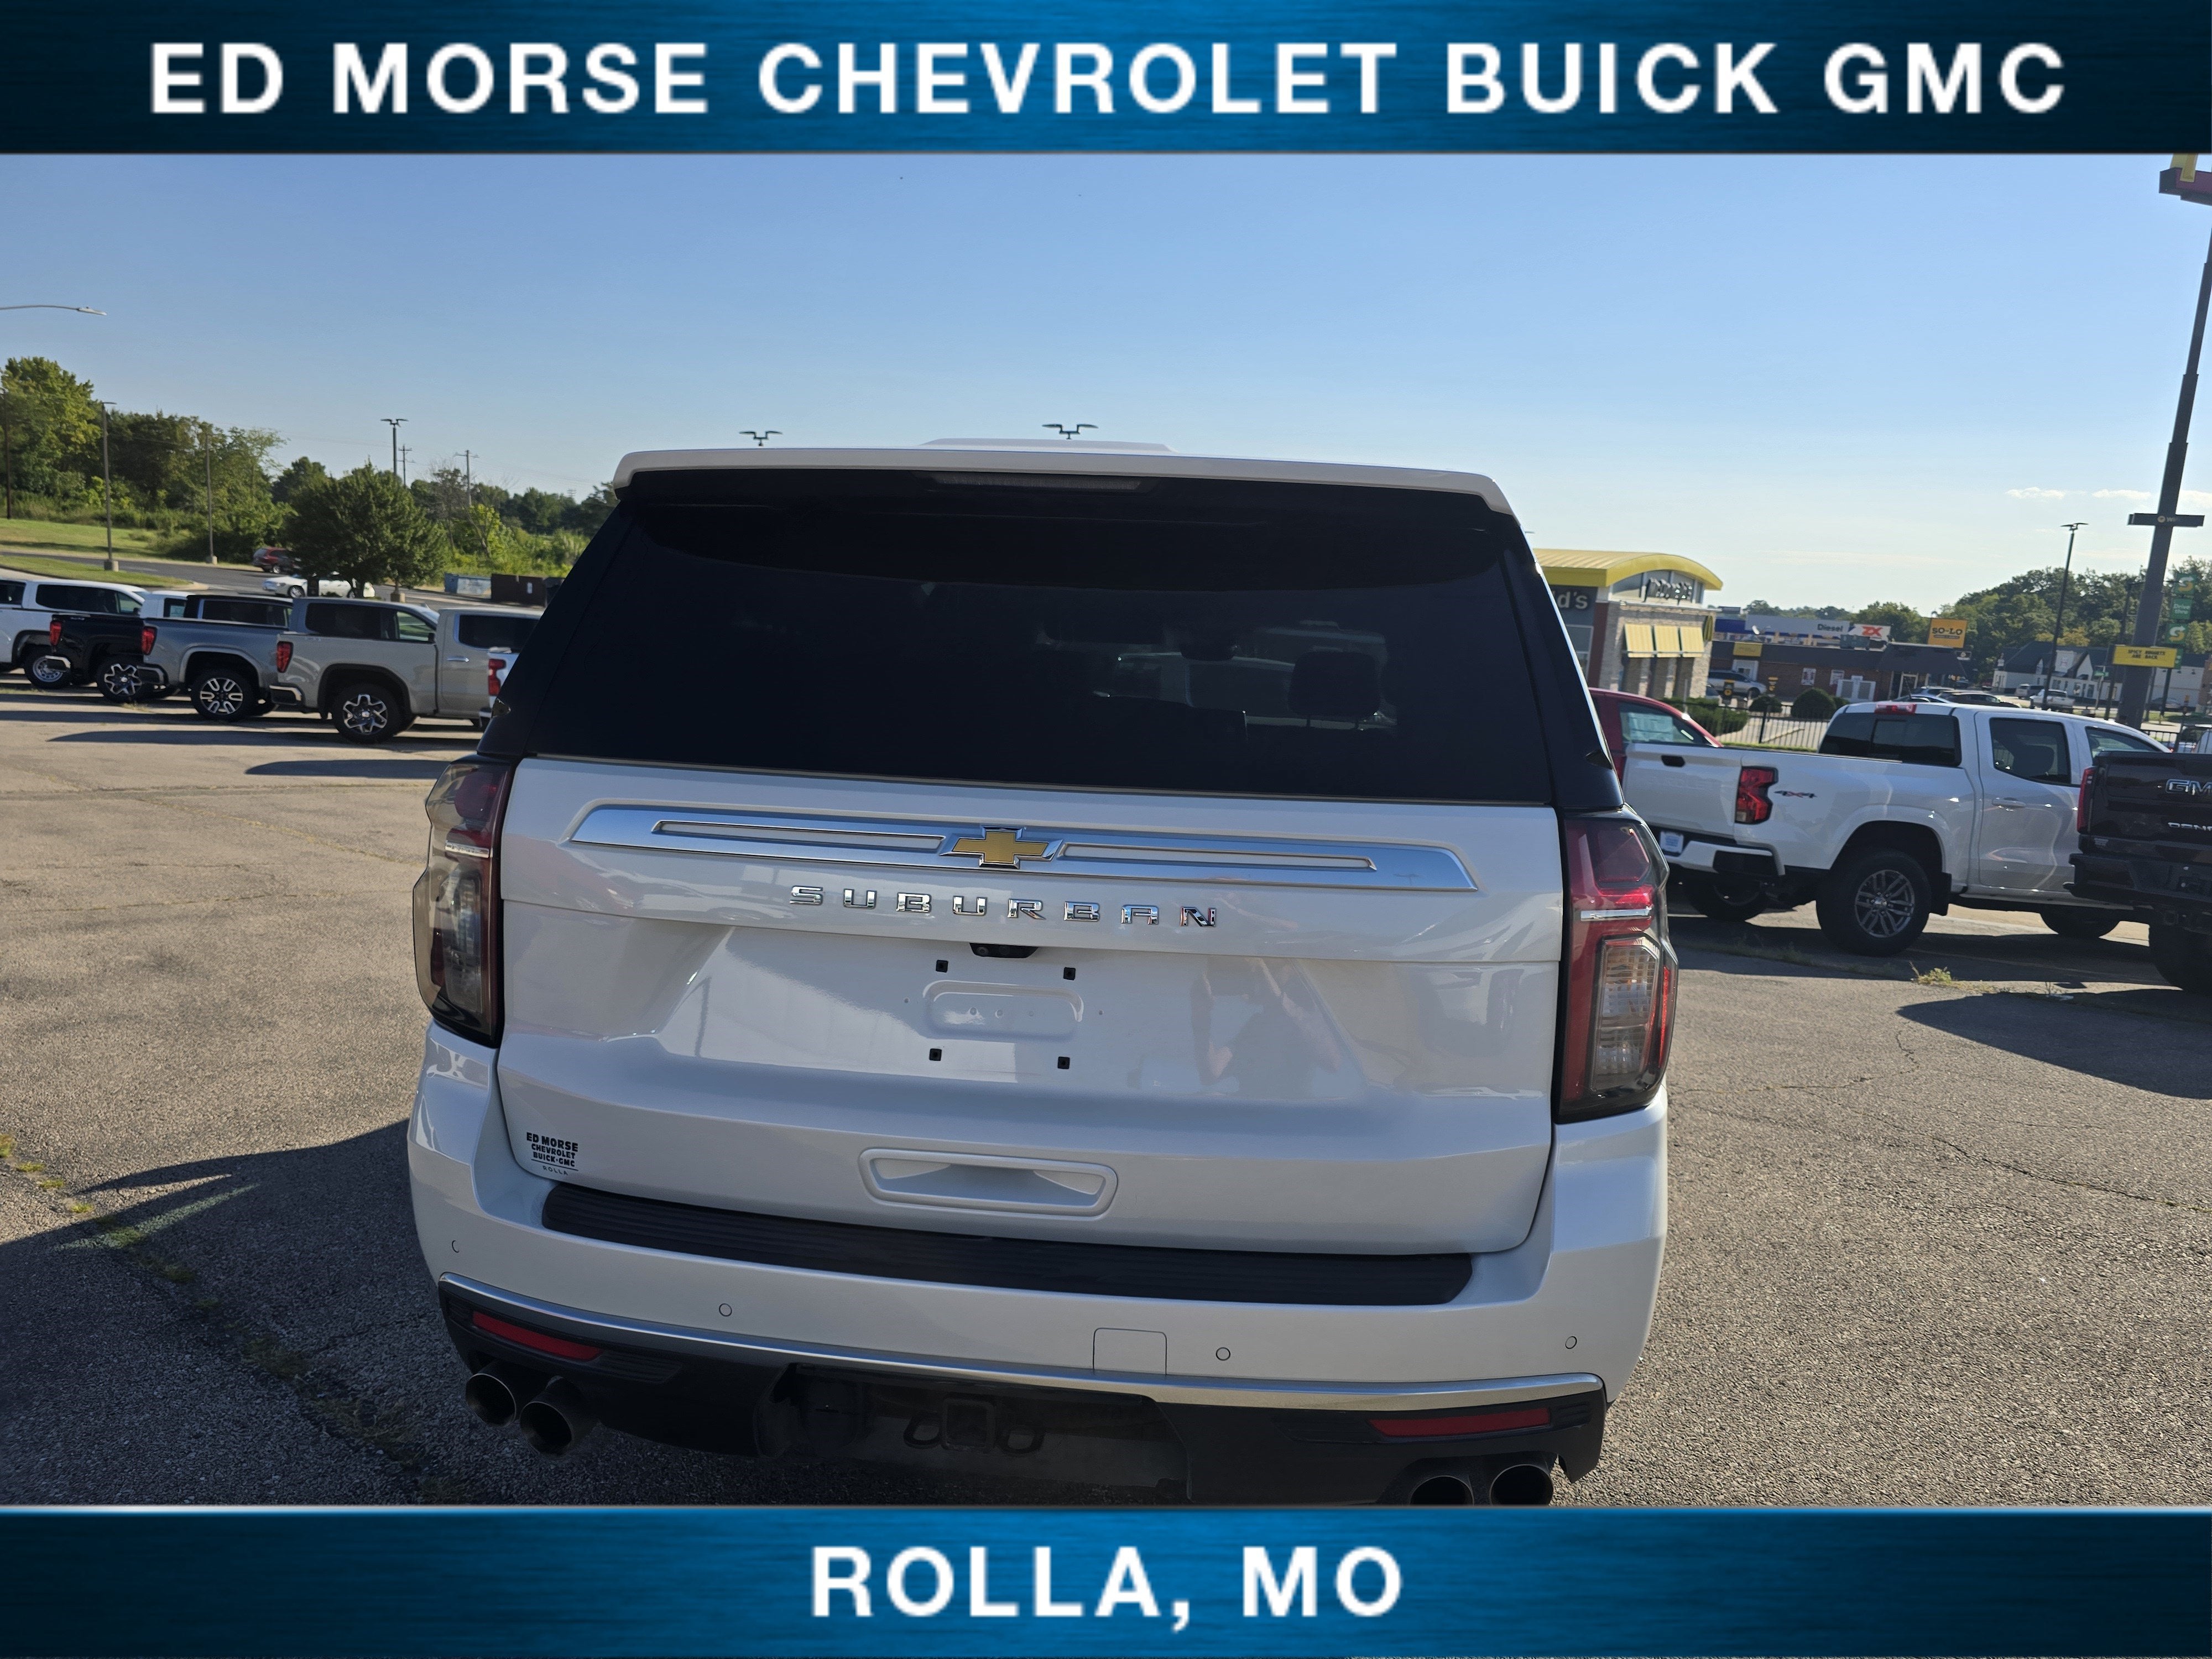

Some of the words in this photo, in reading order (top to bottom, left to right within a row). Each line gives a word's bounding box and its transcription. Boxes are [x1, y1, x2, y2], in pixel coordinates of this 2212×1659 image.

[1817, 623, 1843, 632] Diesel
[1932, 627, 1963, 635] SO-LO
[789, 885, 1217, 927] SUBURBAN
[526, 1132, 539, 1142] ED
[541, 1135, 578, 1152] MORSE
[531, 1143, 576, 1159] CHEVROLET
[542, 1165, 568, 1176] ROLLA
